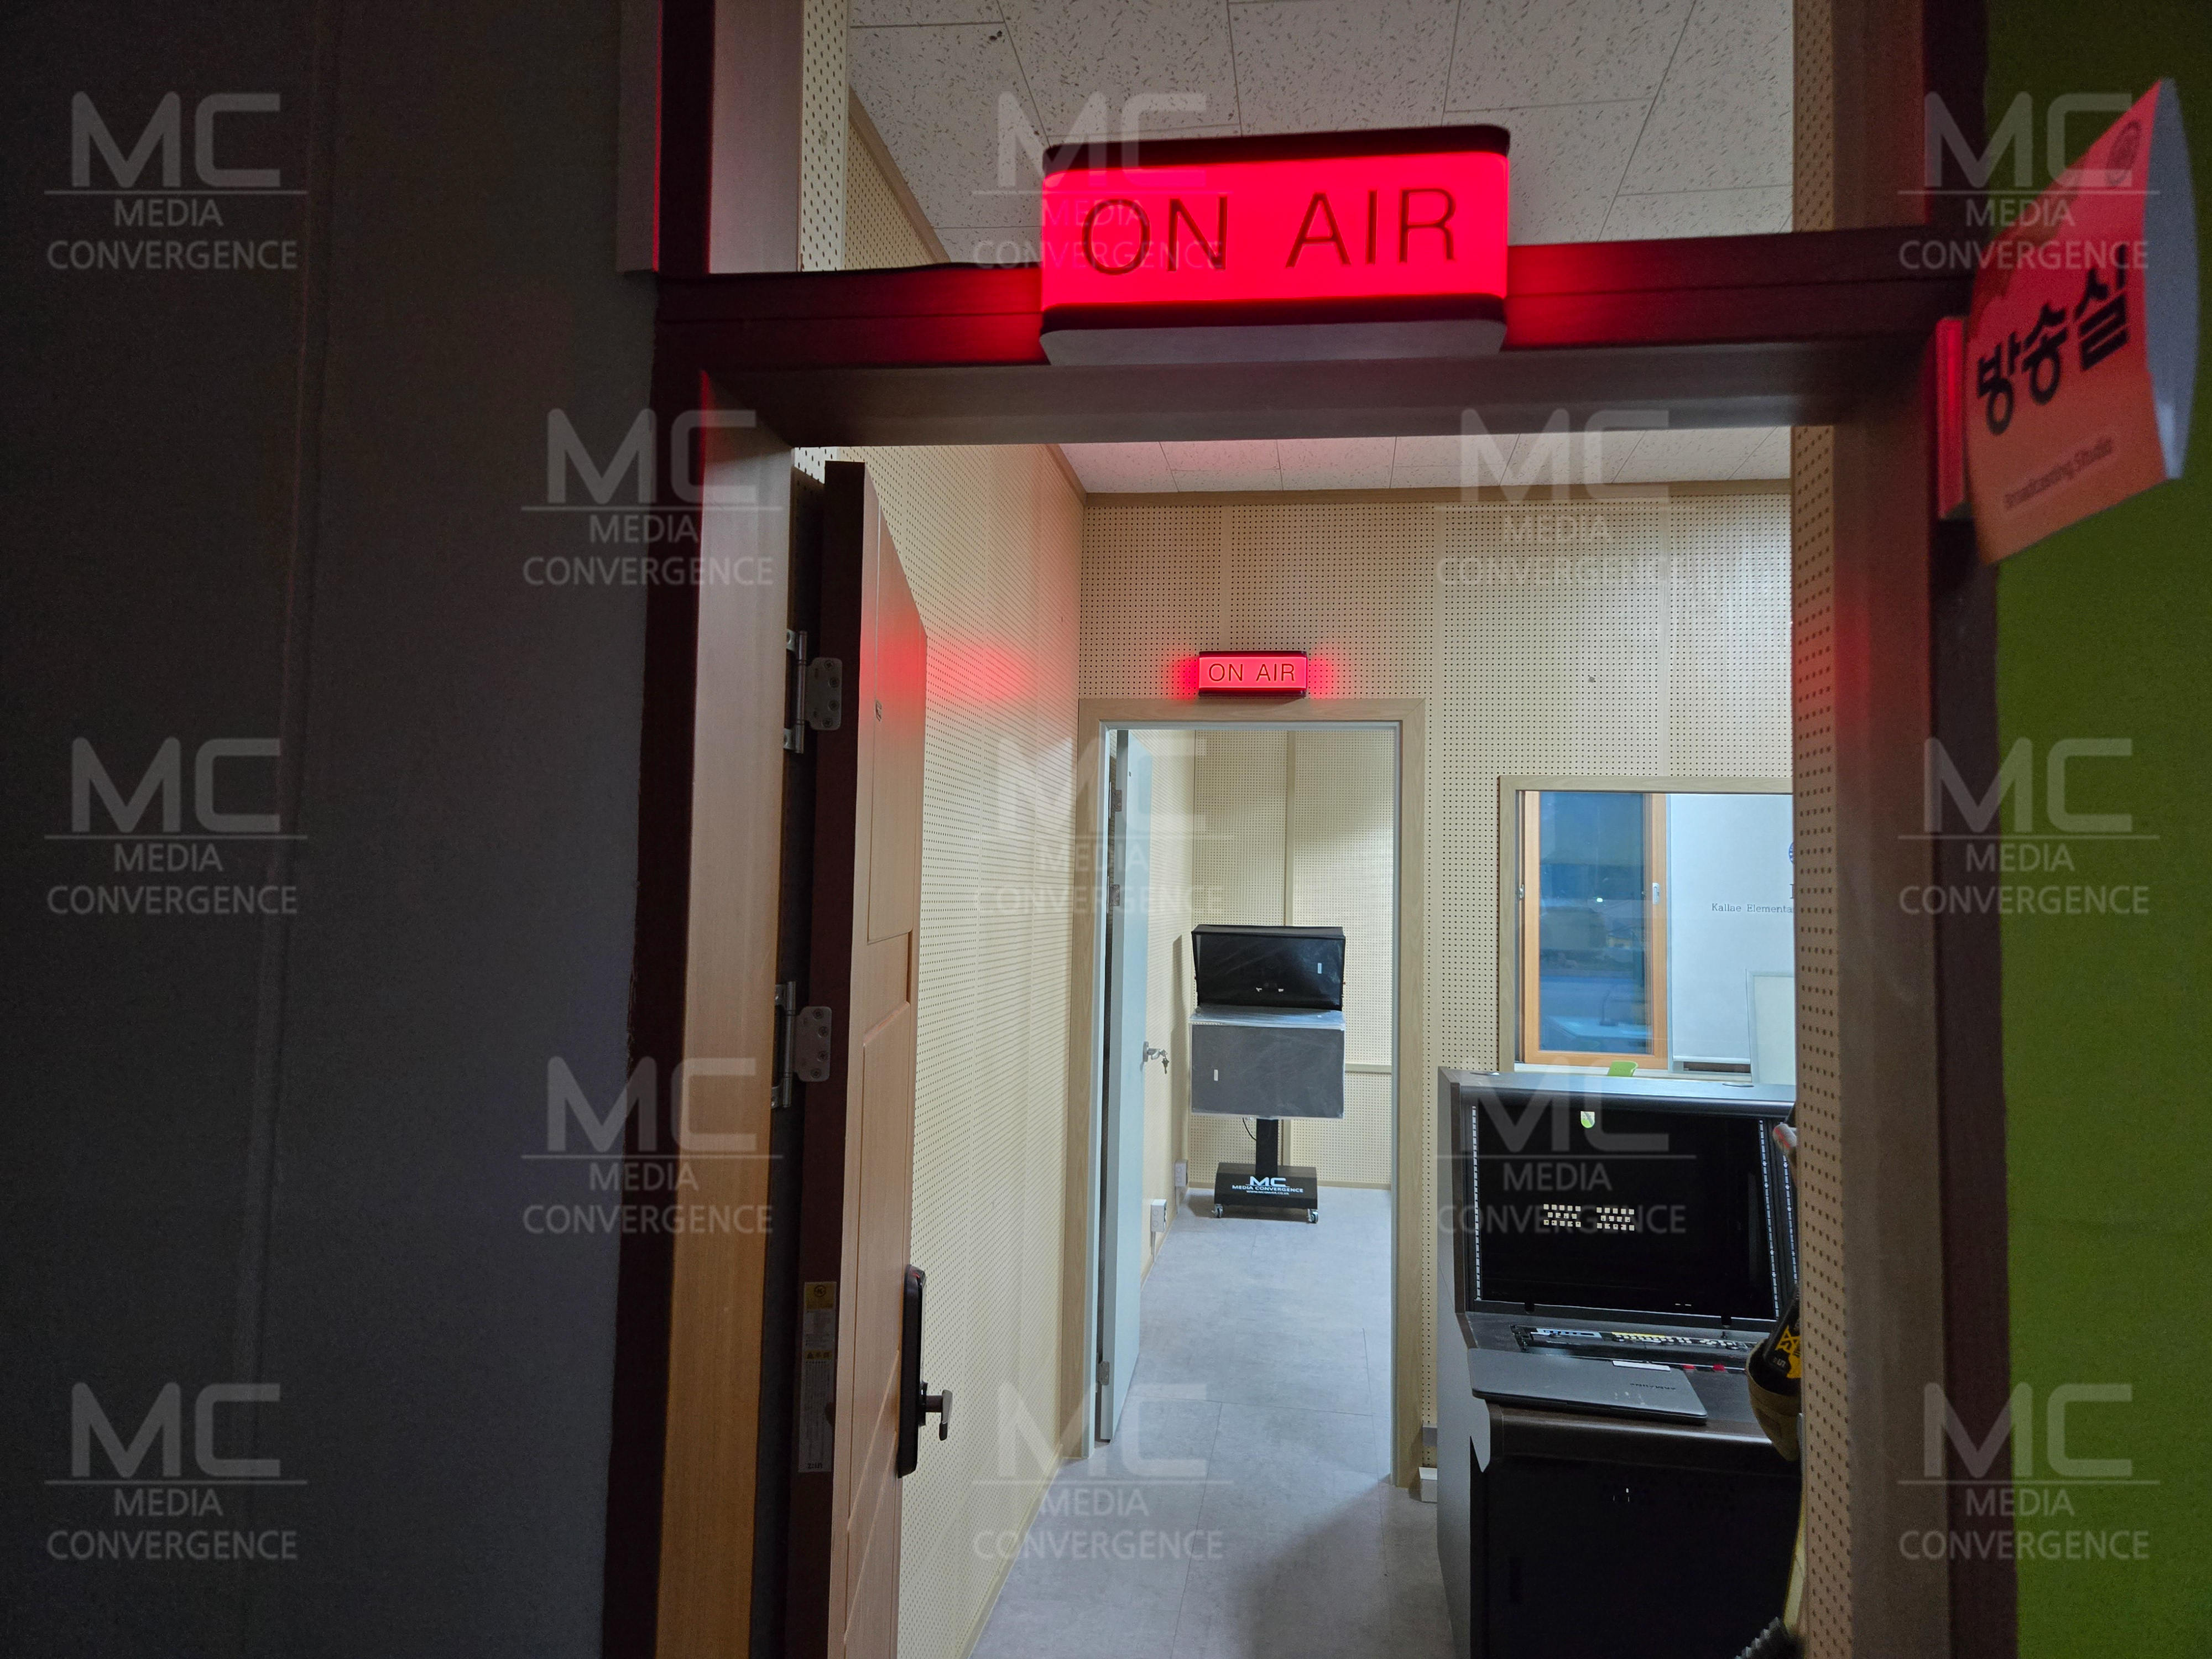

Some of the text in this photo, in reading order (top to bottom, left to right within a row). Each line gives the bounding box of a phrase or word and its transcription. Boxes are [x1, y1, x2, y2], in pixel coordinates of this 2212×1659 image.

[1082, 188, 1457, 275] ON AIR
[1976, 242, 2129, 436] 방송실
[1209, 663, 1295, 682] ON AIR
[1712, 903, 1741, 912] Kallae
[1250, 1176, 1286, 1186] MC
